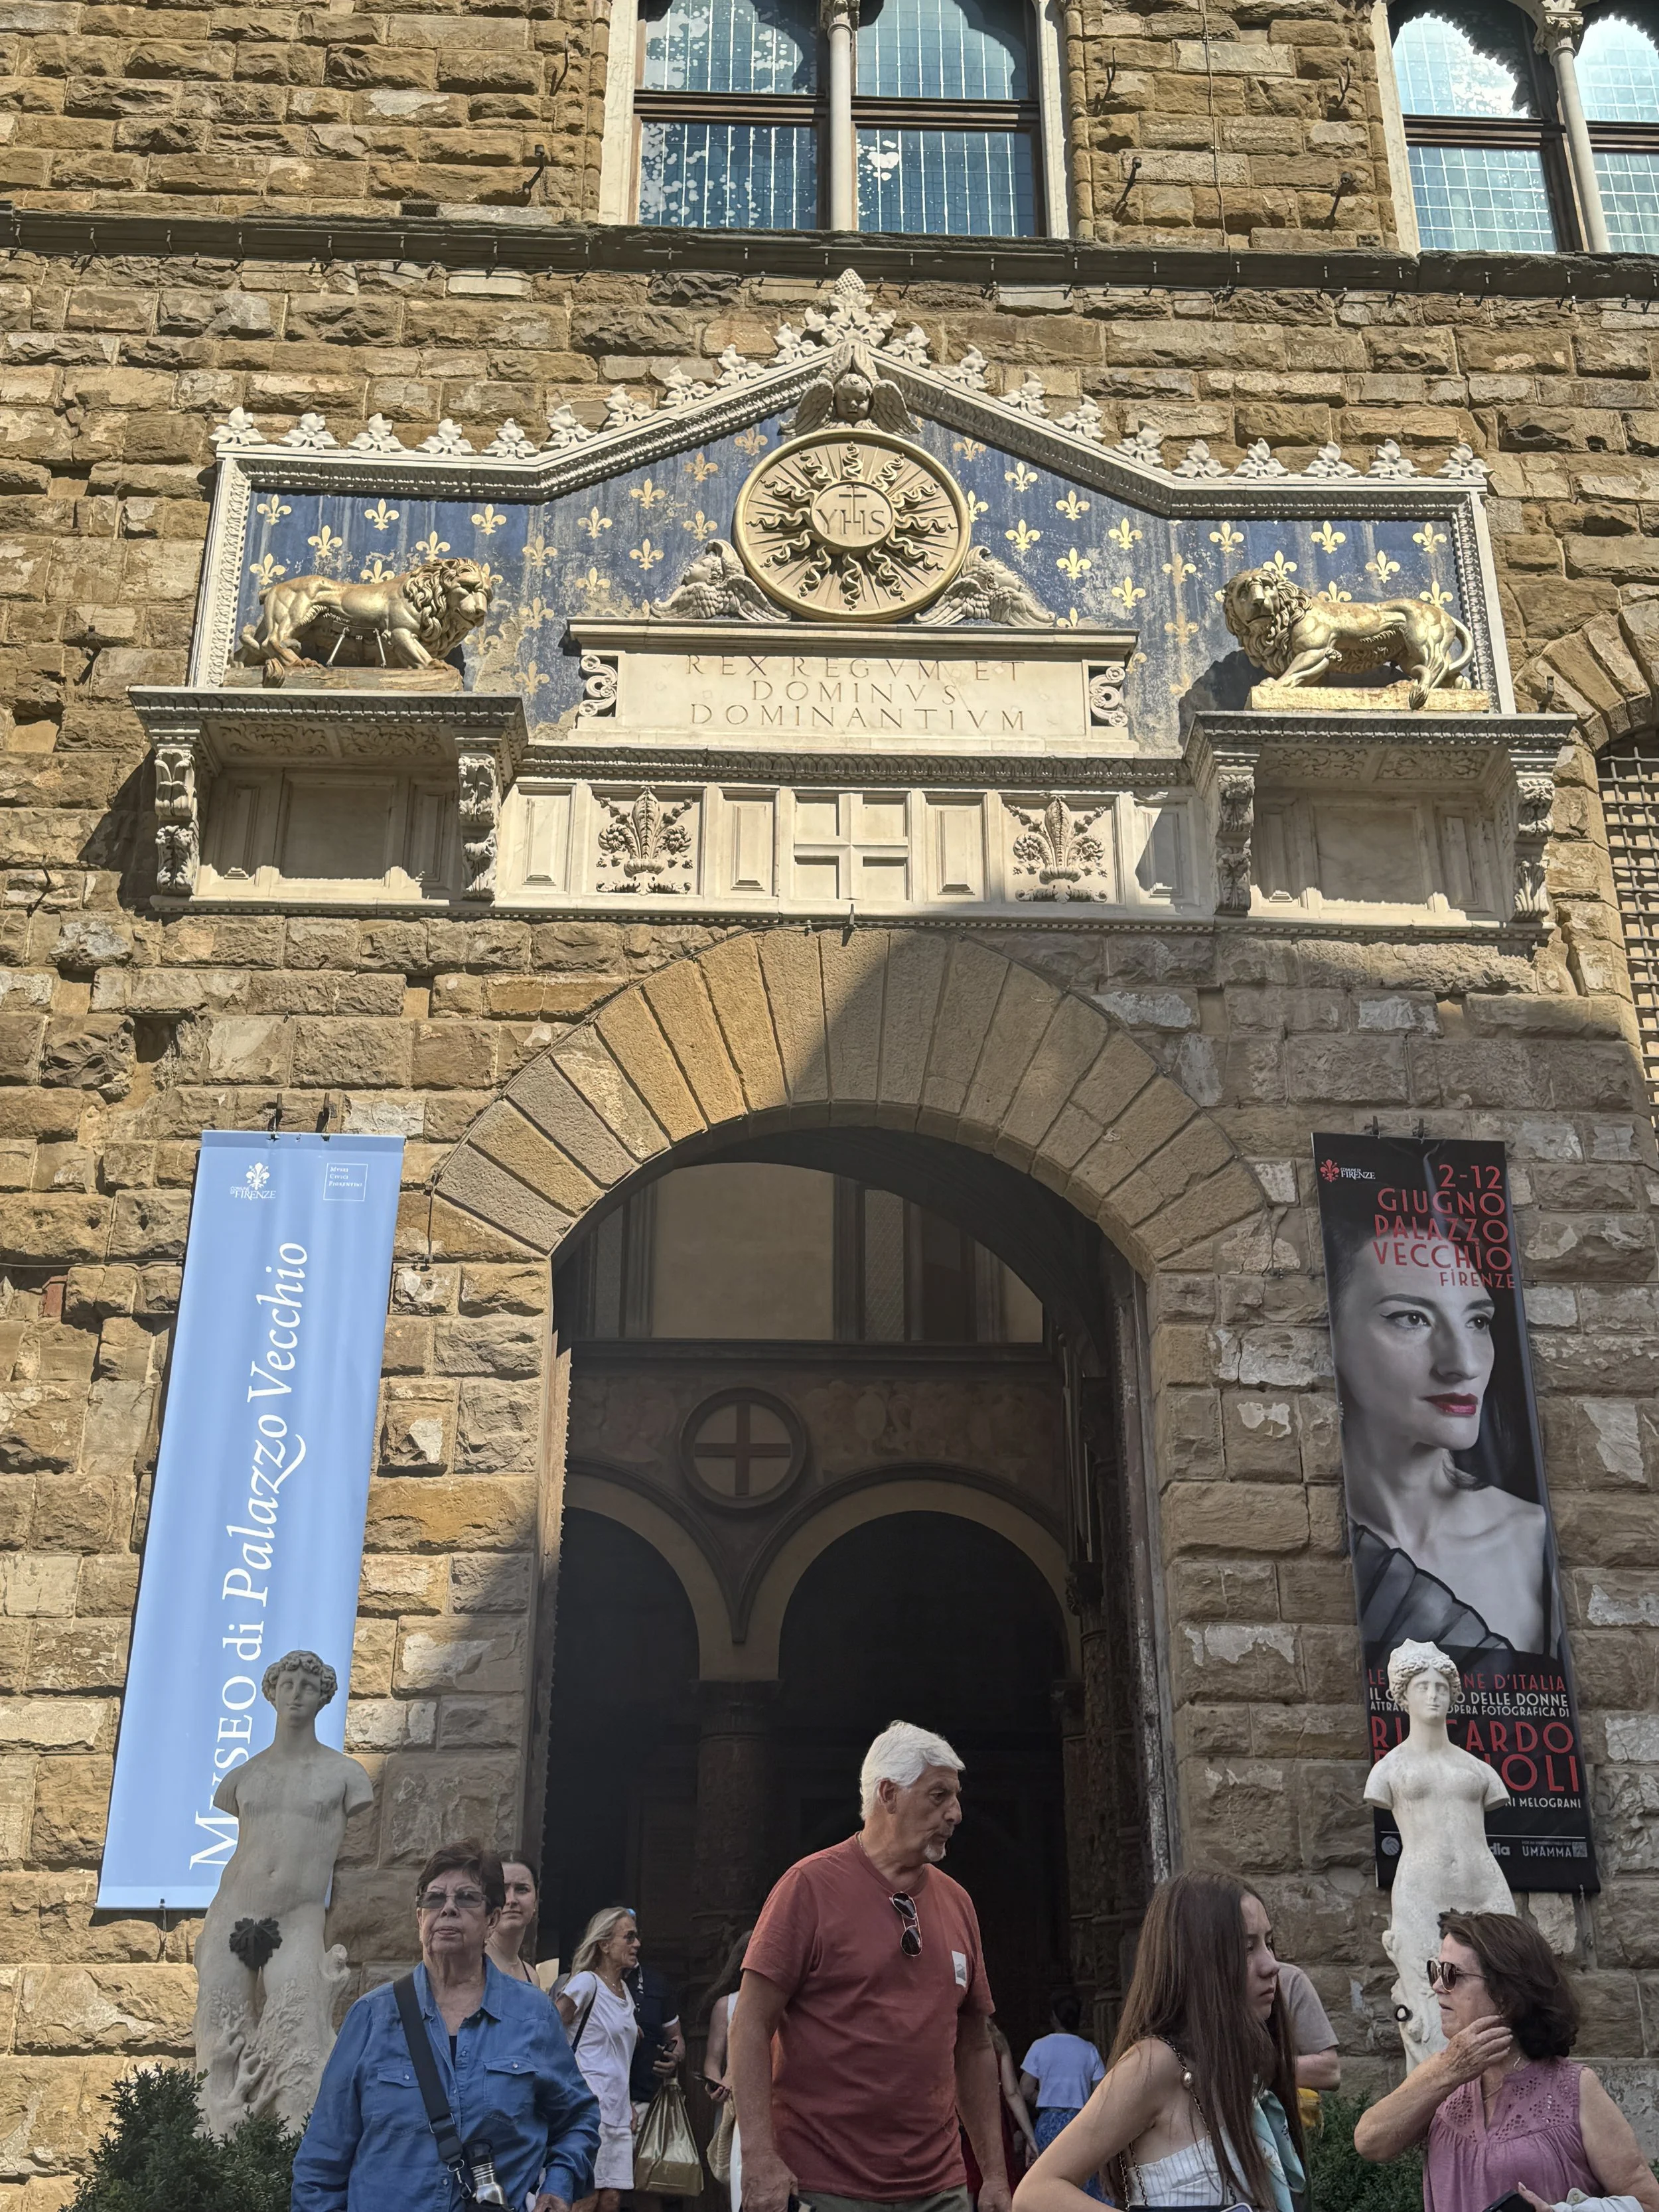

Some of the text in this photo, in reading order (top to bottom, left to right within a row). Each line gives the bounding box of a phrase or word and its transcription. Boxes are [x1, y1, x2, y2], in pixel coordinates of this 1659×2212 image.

[686, 655, 1025, 681] REX REGVM ET
[752, 680, 956, 705] DOMINVS
[691, 703, 1024, 731] DOMINANTIVM
[1340, 1170, 1376, 1180] FIRENZE
[1439, 1164, 1502, 1189] 2-12
[234, 1190, 276, 1201] FIRENZE
[1377, 1188, 1506, 1216] GIUGNO
[1374, 1214, 1508, 1243] PALAZZO
[1373, 1240, 1512, 1271] VECCHIO
[1439, 1269, 1516, 1289] FIRENZE
[188, 1242, 308, 1871] MSEO di Palazzo Vecchio
[1368, 1668, 1386, 1686] LE
[1494, 1673, 1566, 1692] D'ITALIA
[1370, 1686, 1381, 1700] IL
[1471, 1692, 1511, 1705] DELLE
[1516, 1692, 1568, 1707] DONNE
[1481, 1706, 1556, 1717] FOTOGRAFICA
[1559, 1707, 1570, 1718] DI
[1371, 1716, 1574, 1754] RIARDO
[1519, 1797, 1581, 1808] MELOGRANI
[1522, 1845, 1572, 1857] UMAMMA
